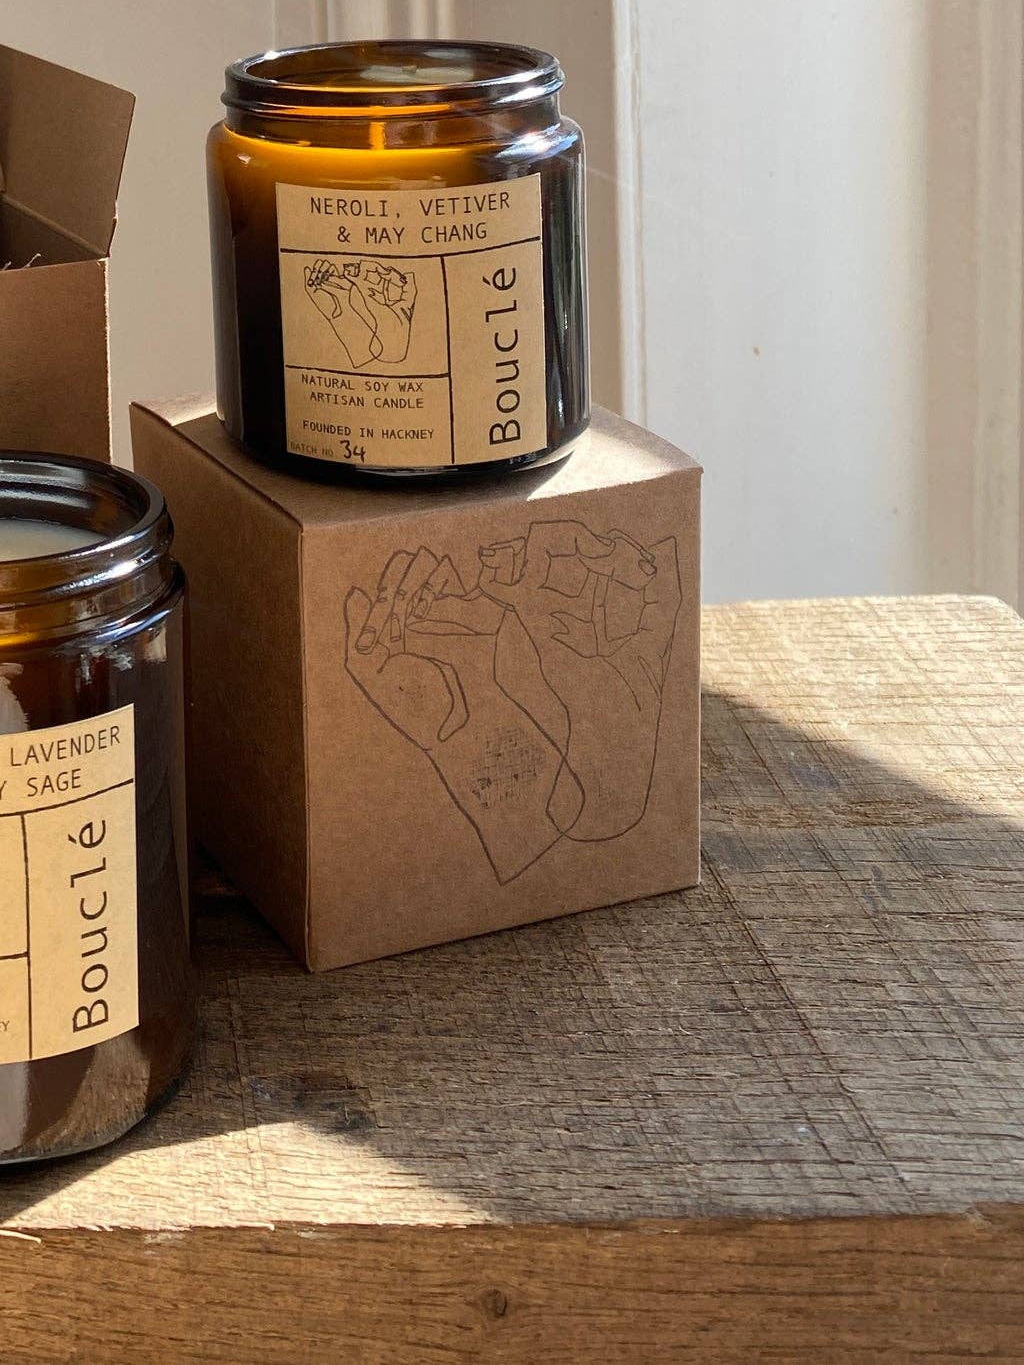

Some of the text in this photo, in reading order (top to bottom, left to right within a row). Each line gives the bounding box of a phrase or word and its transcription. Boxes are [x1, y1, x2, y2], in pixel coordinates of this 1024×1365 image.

[310, 192, 510, 218] NEROLI, VETIVER
[337, 222, 487, 244] & MAY CHANG
[482, 267, 521, 445] Bouclé
[301, 374, 424, 392] NATURAL SOY WAX
[310, 392, 424, 409] ARTISAN CANDLE
[302, 420, 434, 439] FOUNDED IN HACKNEY
[290, 440, 366, 463] BATCH NO 34
[10, 726, 120, 767] LAVENDER
[27, 768, 82, 797] SAGE
[68, 819, 110, 1033] Bouclé
